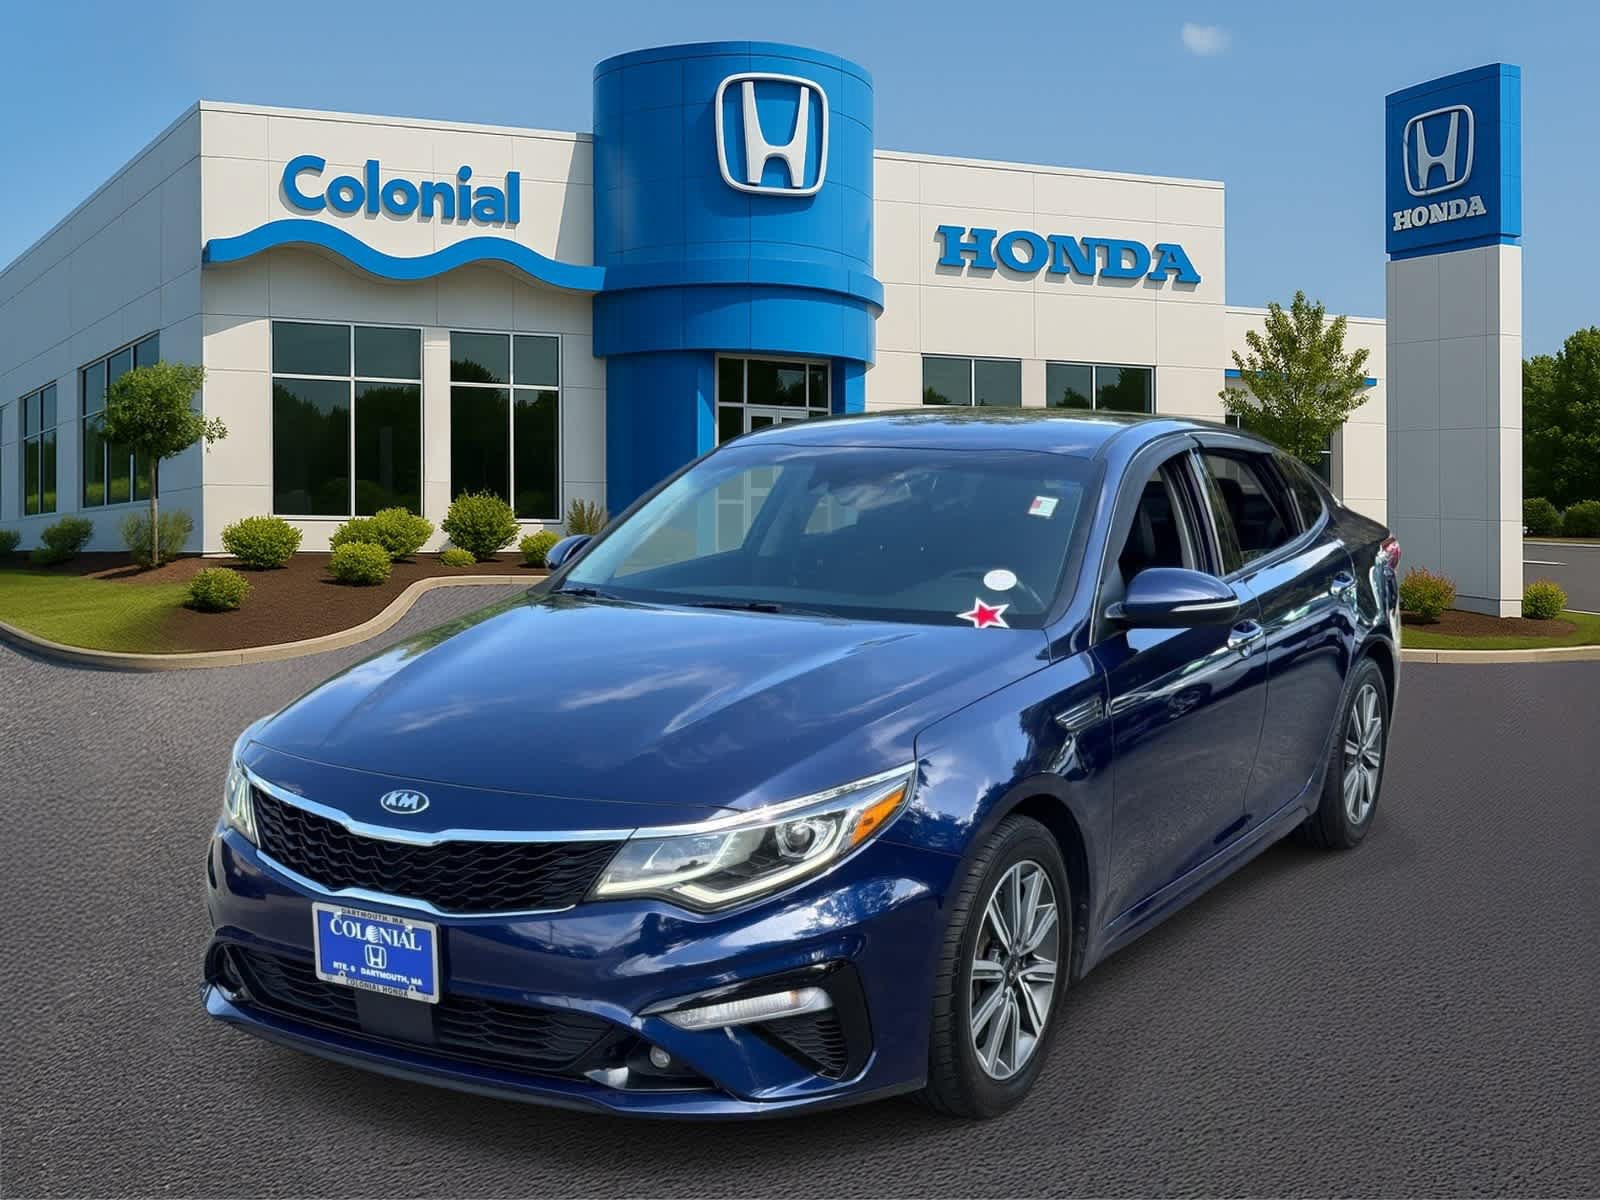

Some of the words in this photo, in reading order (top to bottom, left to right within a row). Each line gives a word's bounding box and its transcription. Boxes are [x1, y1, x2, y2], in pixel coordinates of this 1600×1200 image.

[281, 154, 521, 226] Colonial
[1393, 195, 1487, 231] HONDA
[934, 224, 1202, 286] HONDA
[329, 918, 422, 951] COLONIAL
[360, 967, 409, 984] DARTMOUTH,
[410, 977, 423, 986] MA
